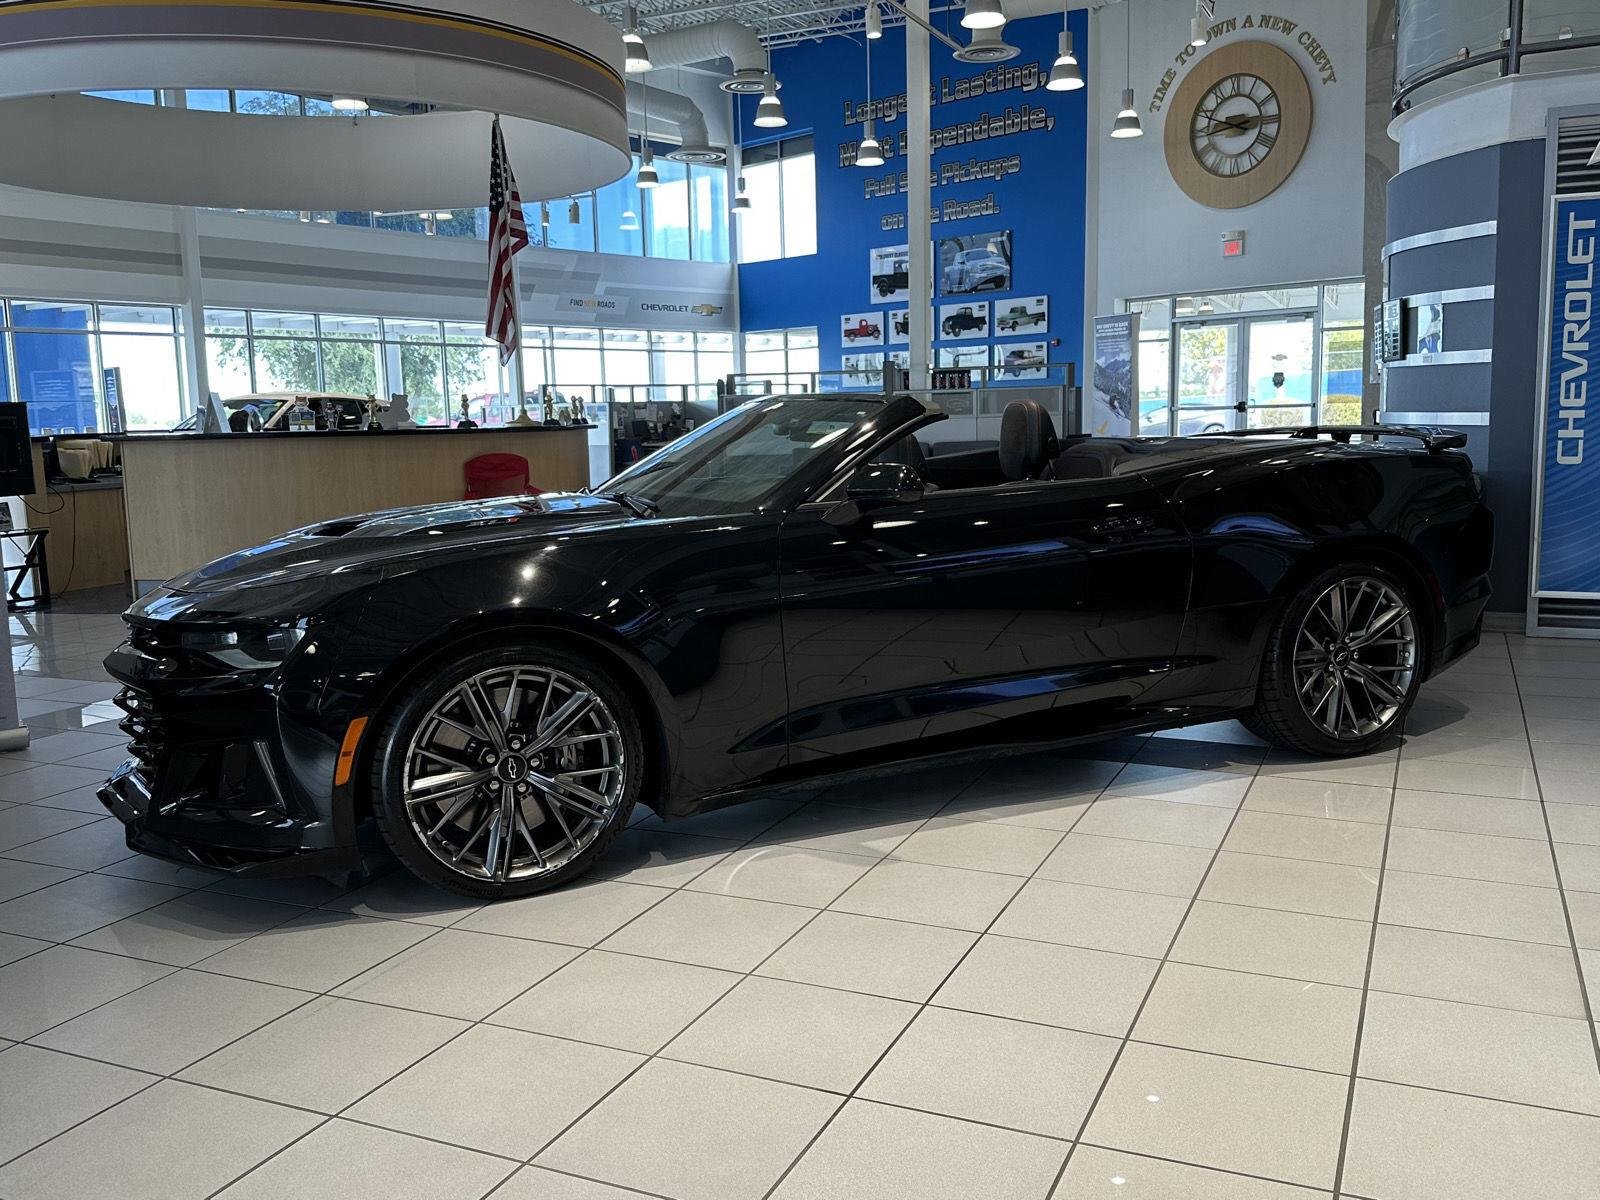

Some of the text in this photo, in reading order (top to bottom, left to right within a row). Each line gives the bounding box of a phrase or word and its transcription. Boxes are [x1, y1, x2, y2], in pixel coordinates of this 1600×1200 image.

[1150, 68, 1177, 113] TIME
[1175, 43, 1197, 66] TO
[1241, 14, 1254, 29] A
[1257, 14, 1298, 37] NEW
[1297, 31, 1337, 86] CHEVY
[844, 62, 1048, 126] Longet Lasting,
[839, 104, 1055, 169] Mt Dpendable,
[864, 153, 1021, 199] Full Se Pickups
[881, 212, 905, 231] on
[943, 194, 1000, 222] Road.
[569, 298, 584, 307] FIND
[641, 303, 689, 313] CHEVROLET
[1556, 212, 1596, 465] CHEVROLET
